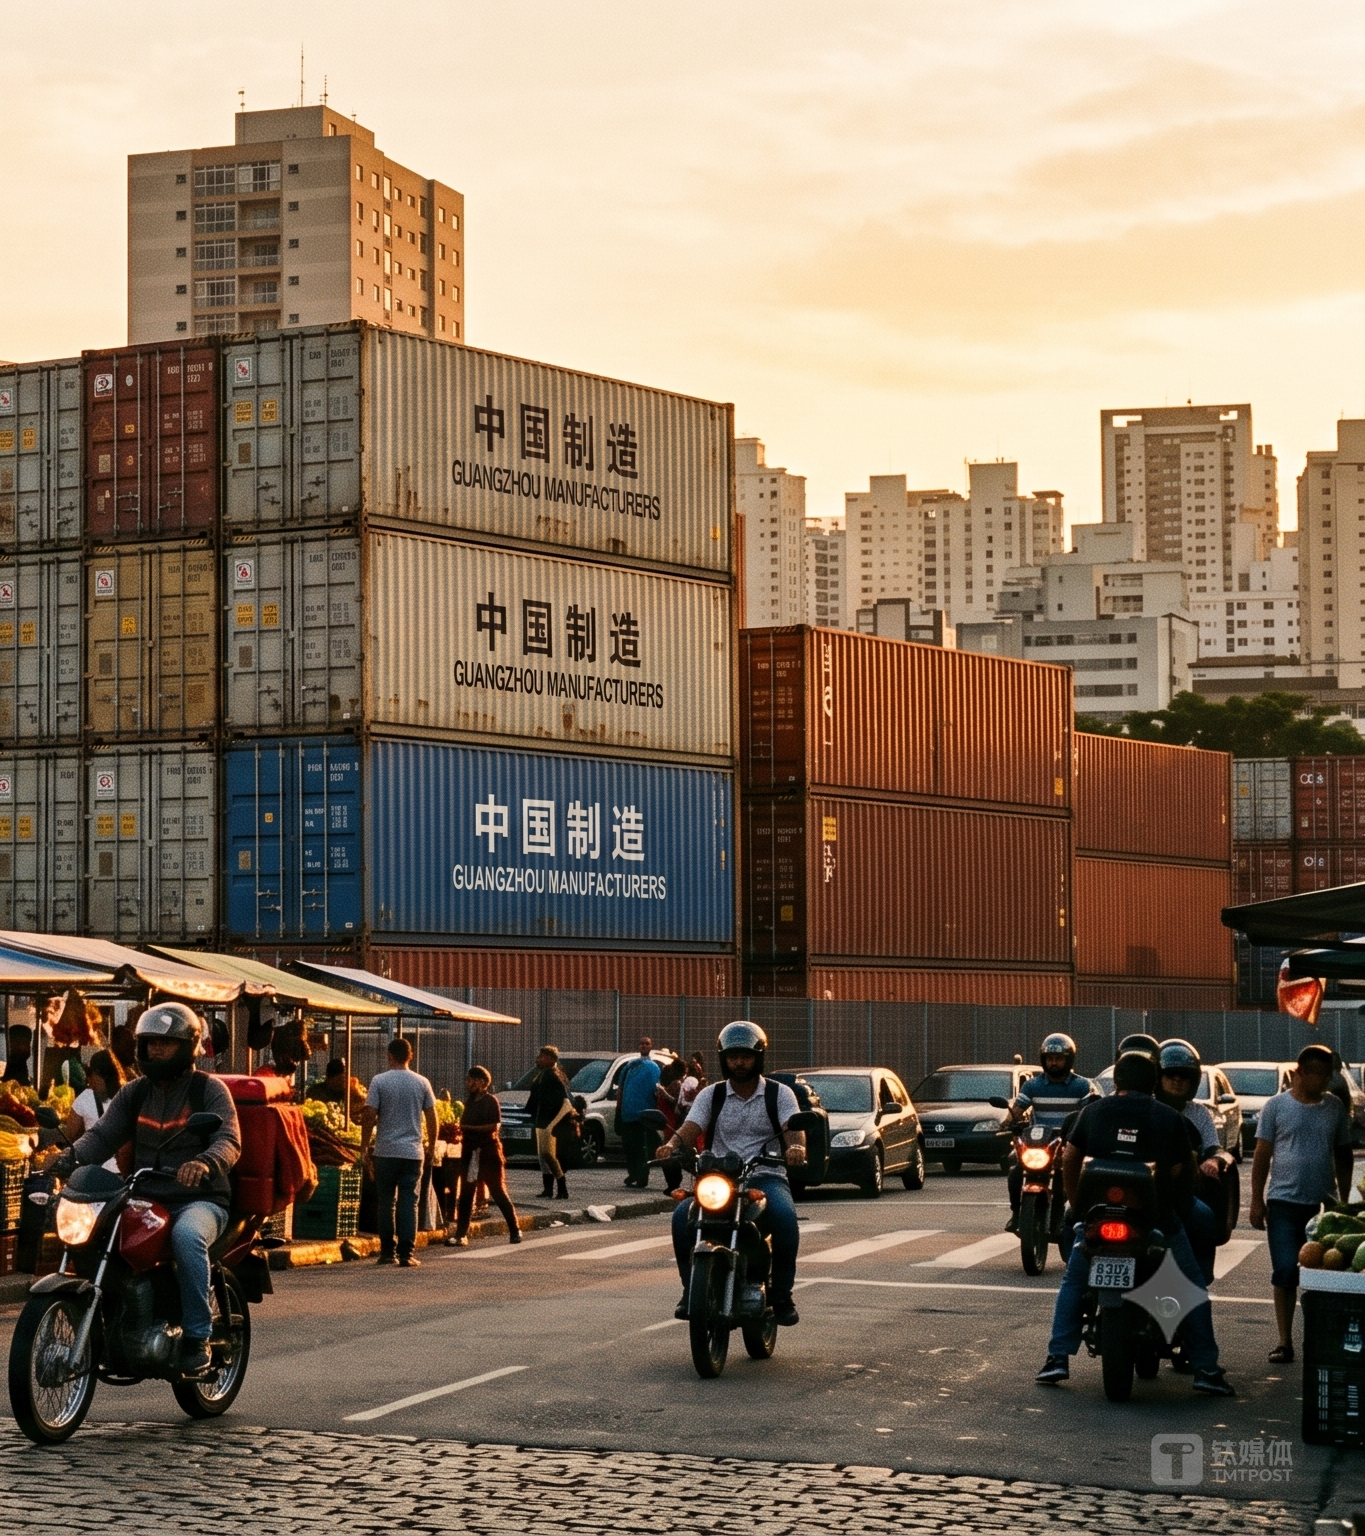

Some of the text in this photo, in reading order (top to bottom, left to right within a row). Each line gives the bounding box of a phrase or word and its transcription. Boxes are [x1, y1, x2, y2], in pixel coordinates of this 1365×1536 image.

[474, 394, 638, 479] 中国制造
[452, 459, 661, 521] GUANGZHOU MANUFACTURERS
[476, 591, 641, 668] 中国制造
[454, 659, 664, 709] GUANGZHOU MANUFACTURERS
[475, 793, 645, 862] 中国制造
[453, 864, 666, 900] GUANGZHOU MANUFACTURERS
